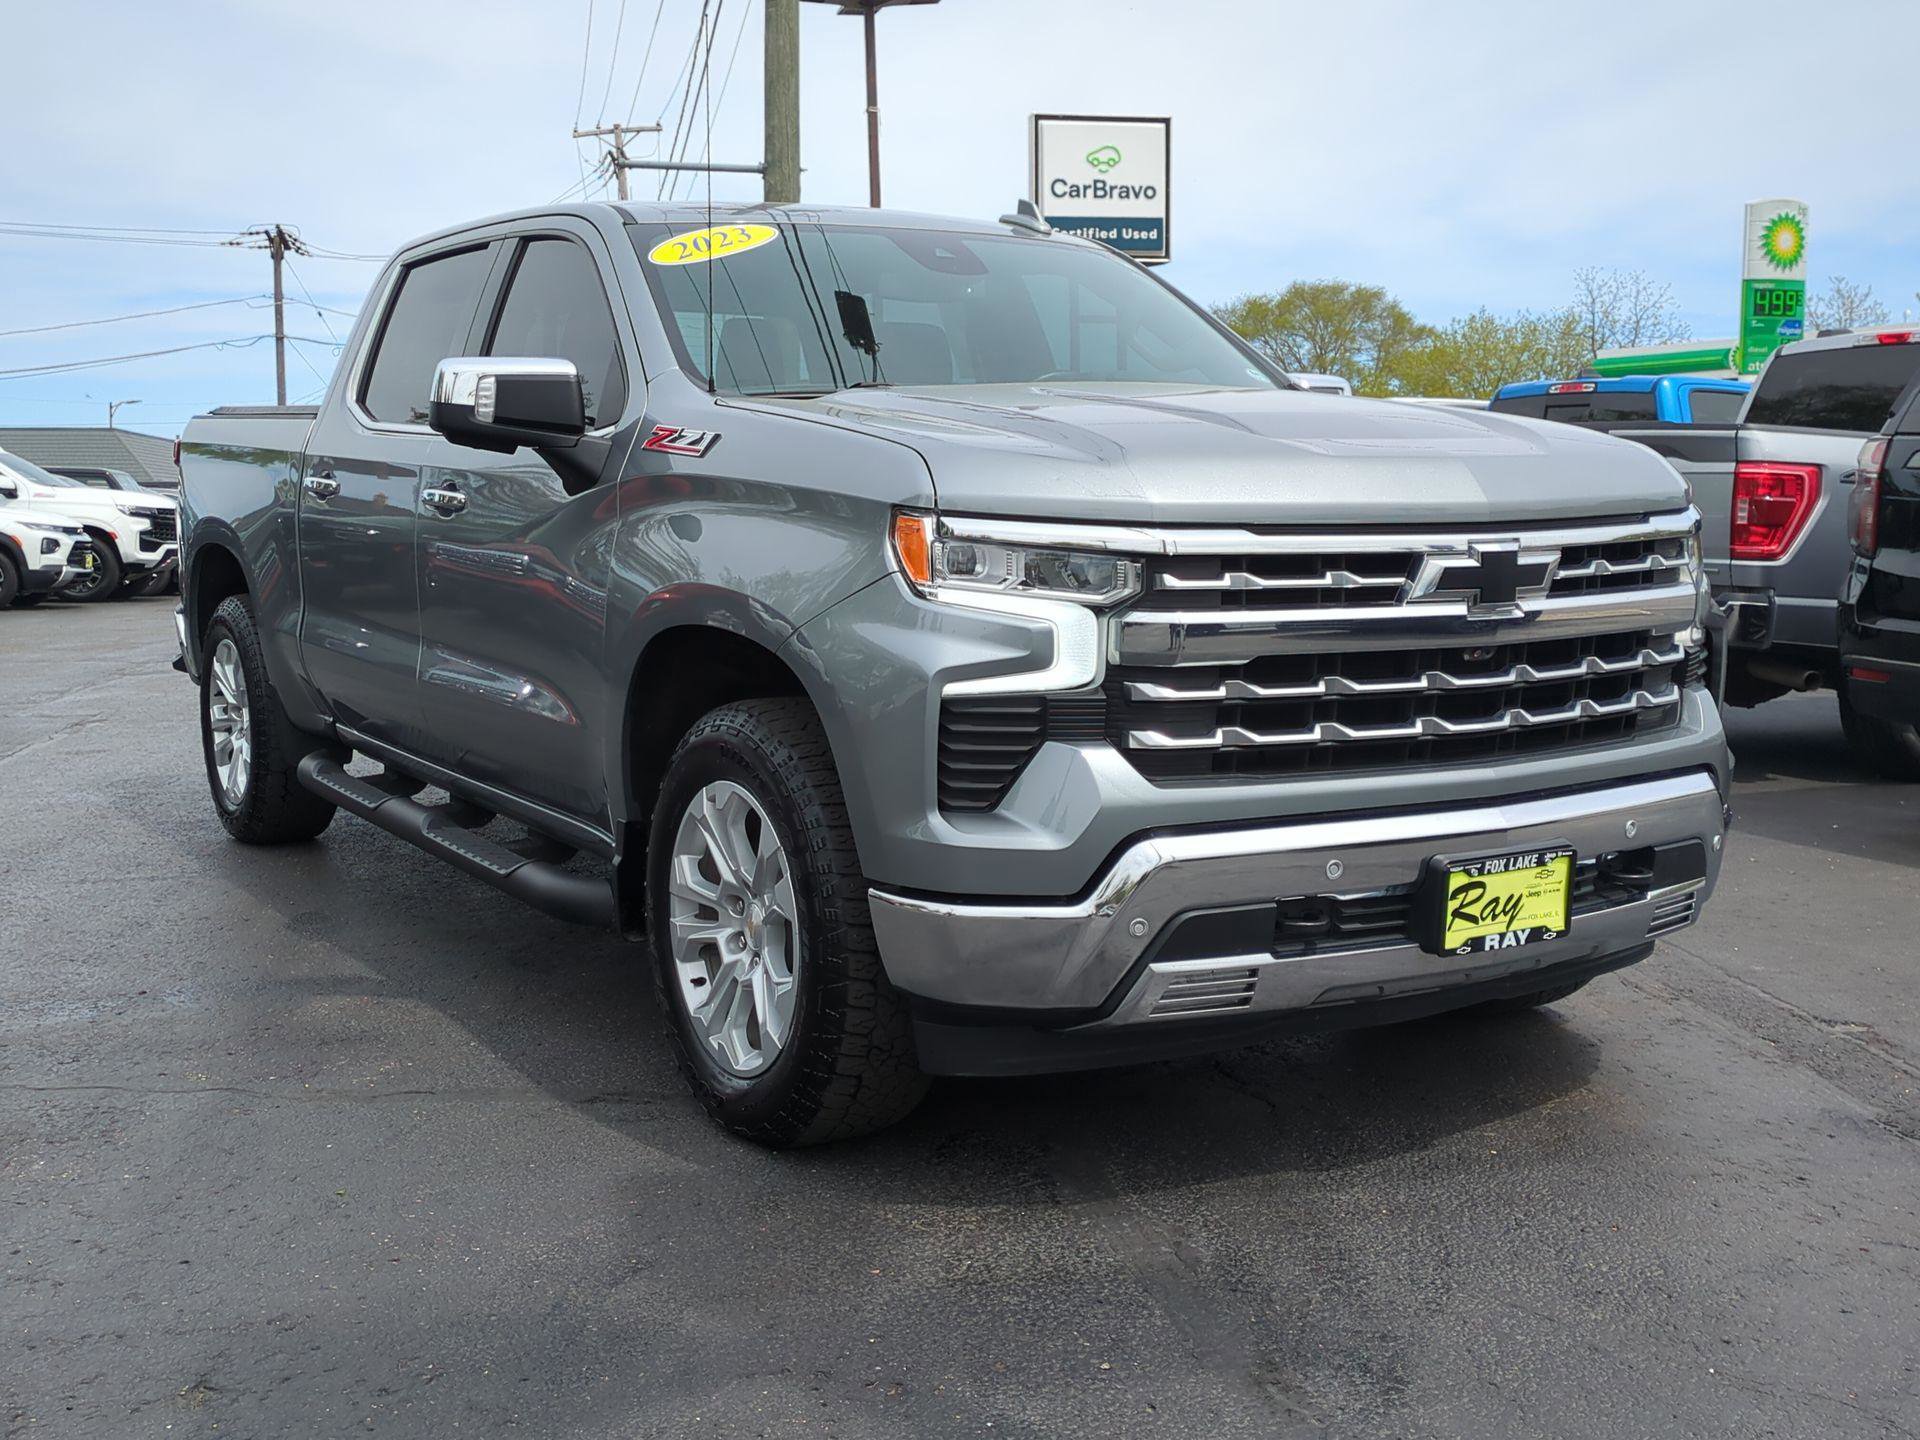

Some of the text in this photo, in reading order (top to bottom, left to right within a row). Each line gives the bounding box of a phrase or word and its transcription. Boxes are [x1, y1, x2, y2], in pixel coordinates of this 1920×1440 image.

[1051, 178, 1157, 199] CarBravo
[671, 225, 753, 260] 2023
[1122, 228, 1158, 240] Used
[641, 424, 723, 458] Z71
[1484, 854, 1539, 875] FOX LAKE
[1525, 890, 1542, 898] Jeep
[1447, 881, 1525, 931] Ray
[1484, 928, 1531, 951] RAY
